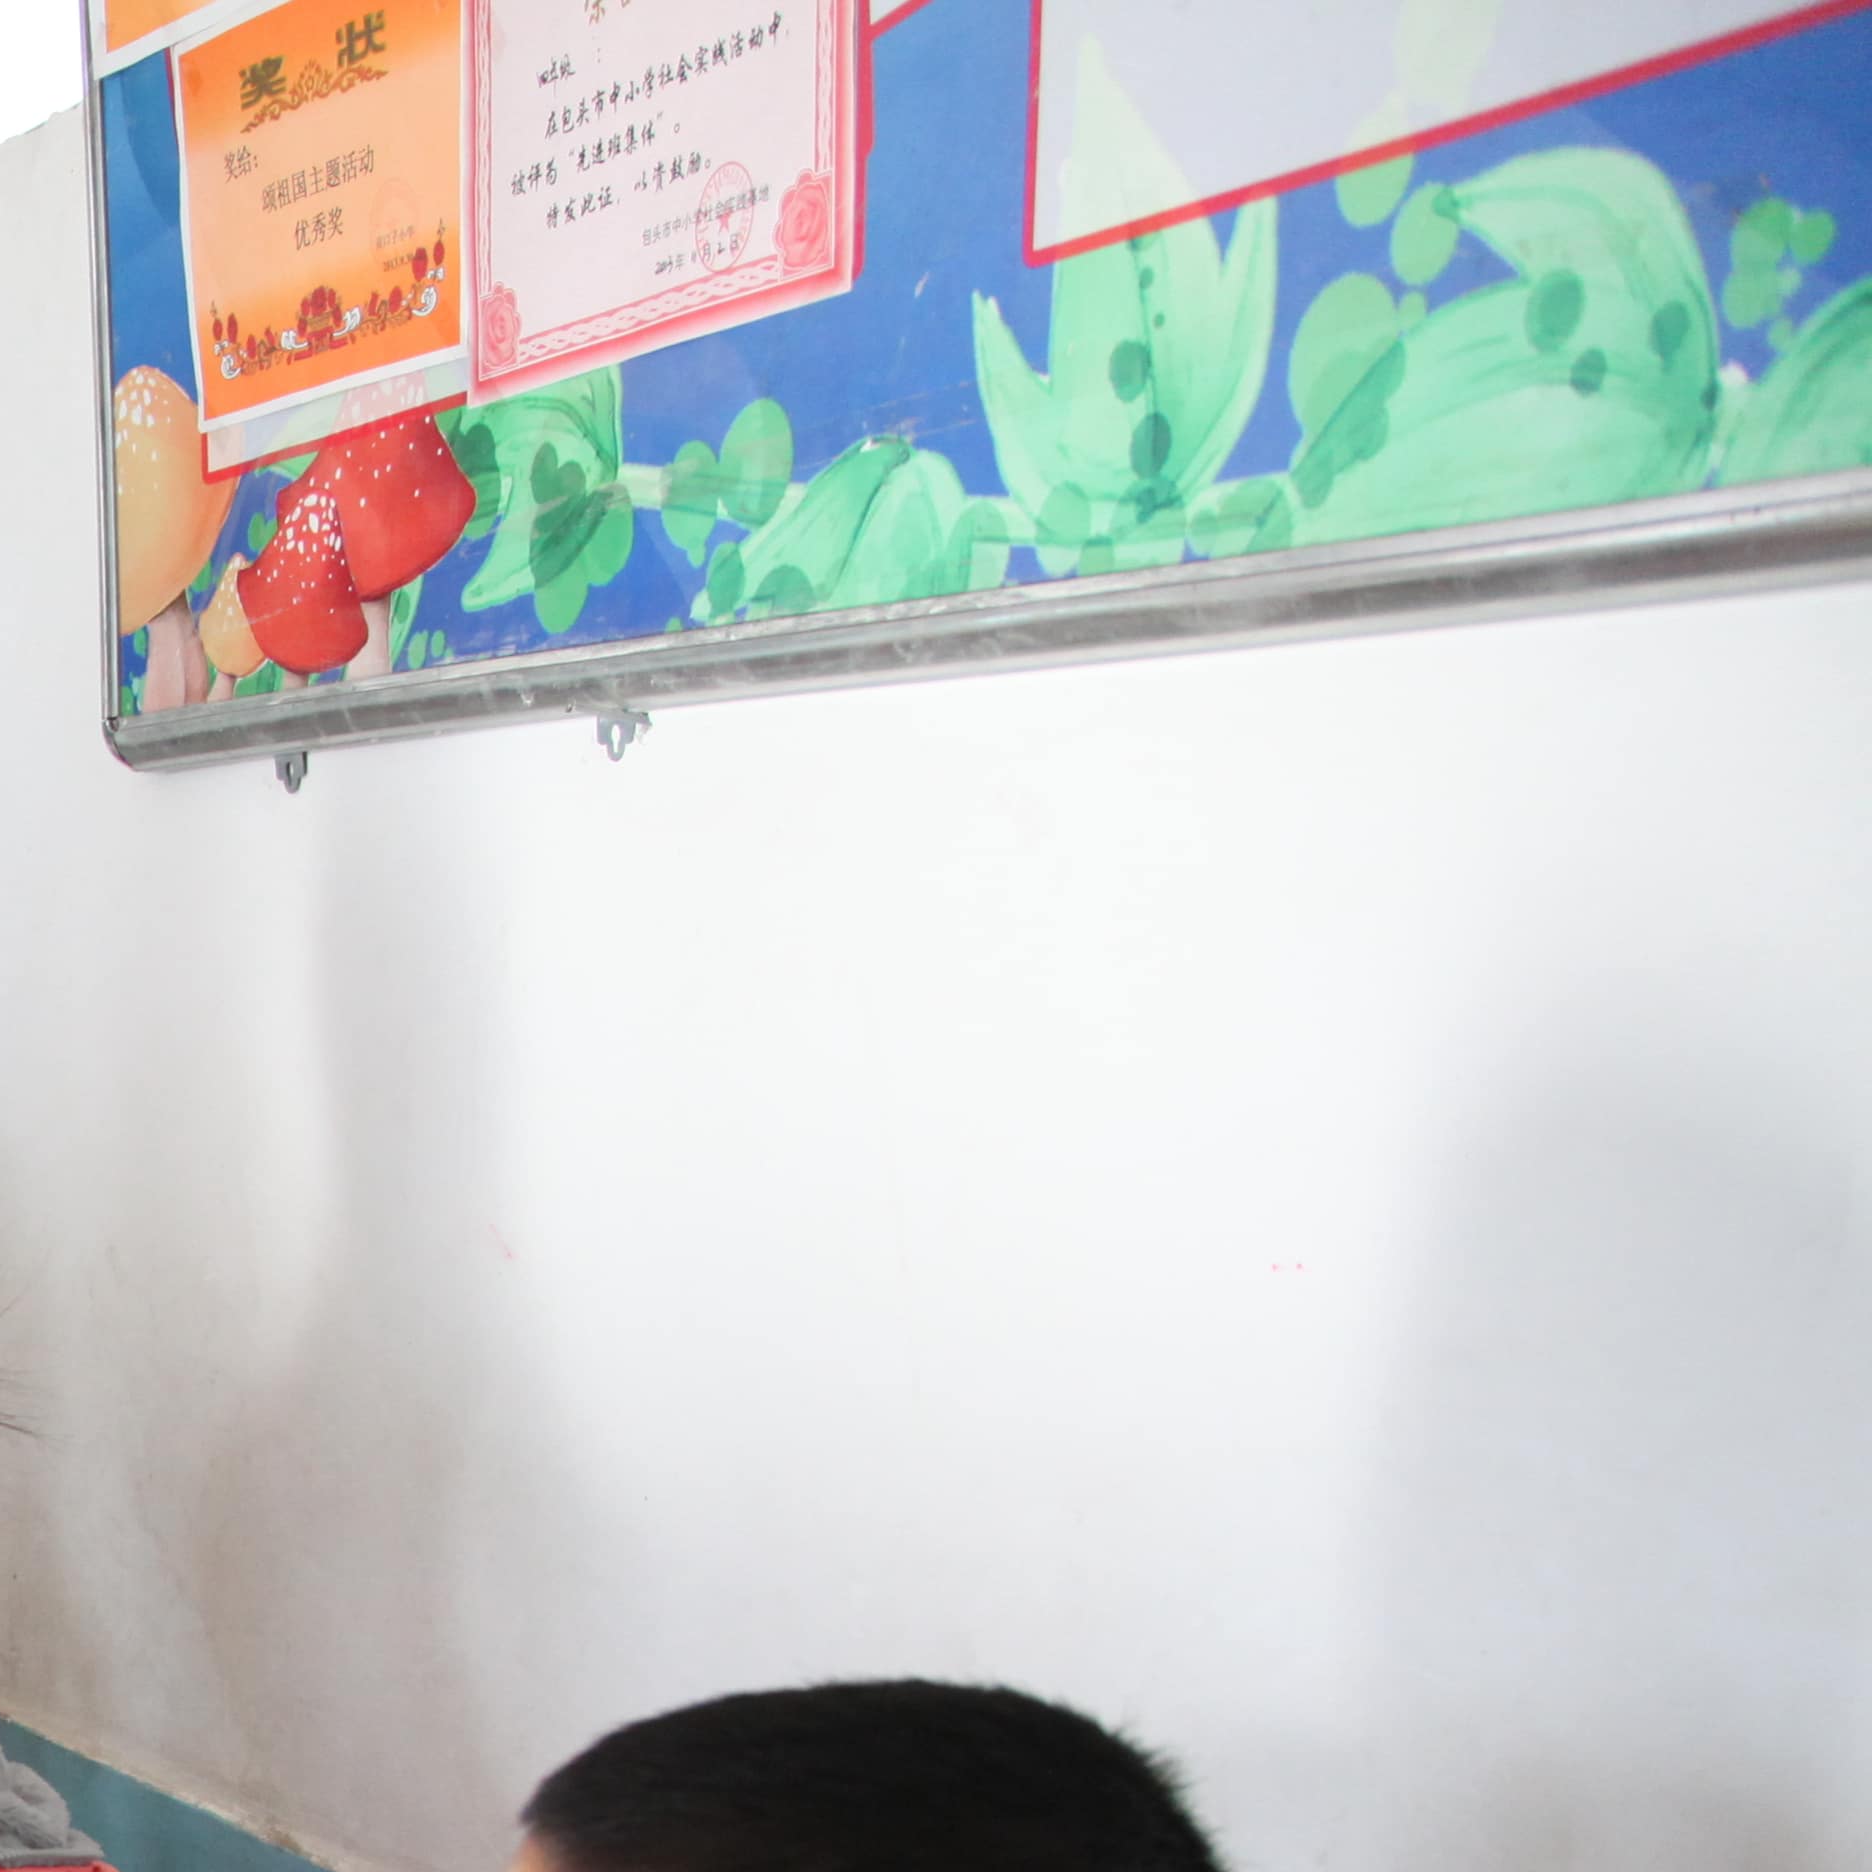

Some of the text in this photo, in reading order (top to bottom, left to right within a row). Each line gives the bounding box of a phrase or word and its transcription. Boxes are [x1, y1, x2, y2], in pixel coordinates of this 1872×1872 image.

[238, 9, 387, 111] 奖状
[294, 205, 344, 251] 优秀奖
